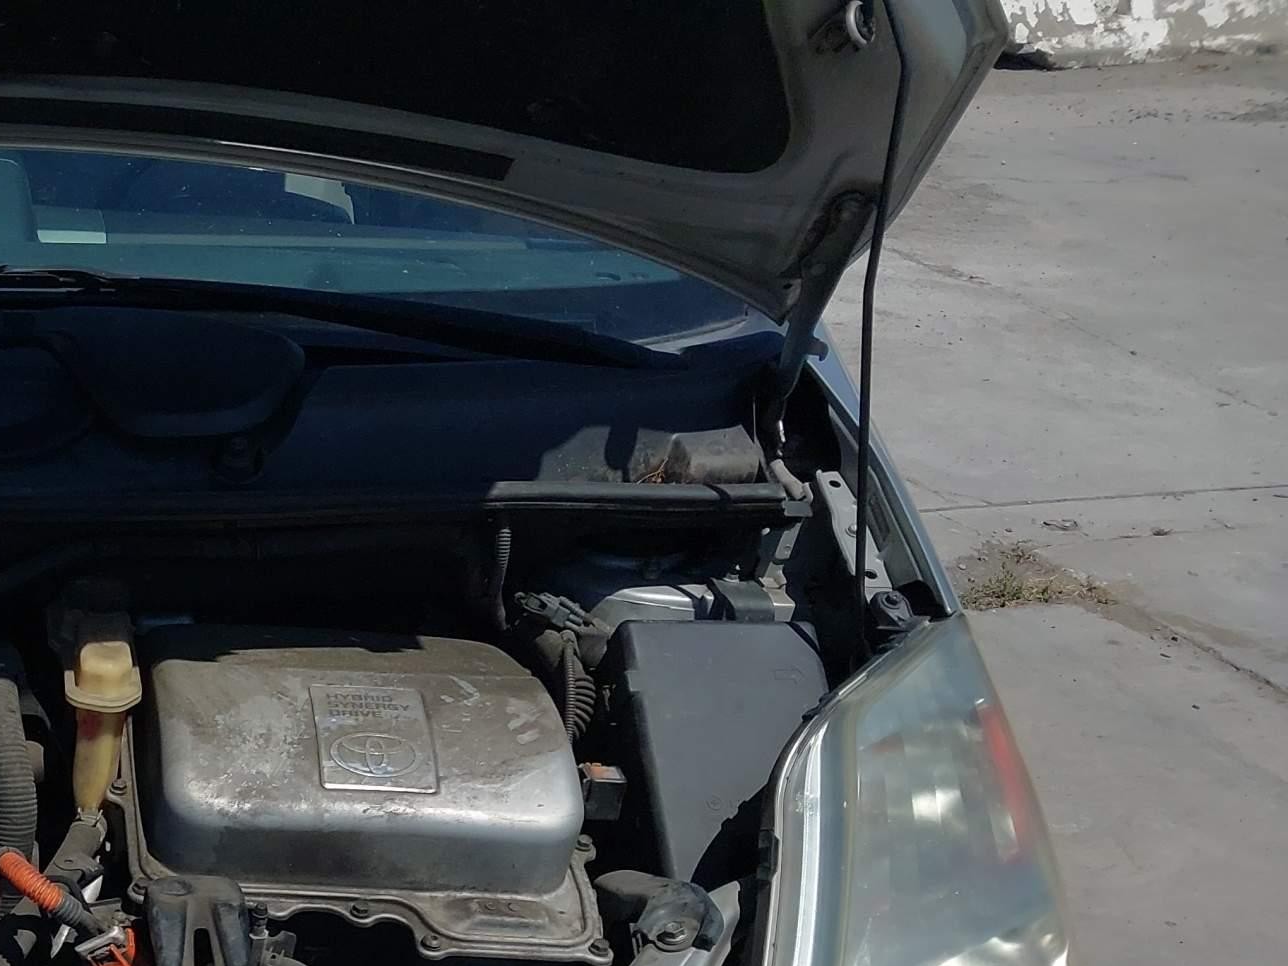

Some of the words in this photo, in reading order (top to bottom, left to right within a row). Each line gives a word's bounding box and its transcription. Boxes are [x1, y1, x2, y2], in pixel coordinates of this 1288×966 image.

[326, 693, 393, 703] HYBRID
[327, 701, 409, 711] SYNERGY
[328, 709, 384, 718] DRIVE
